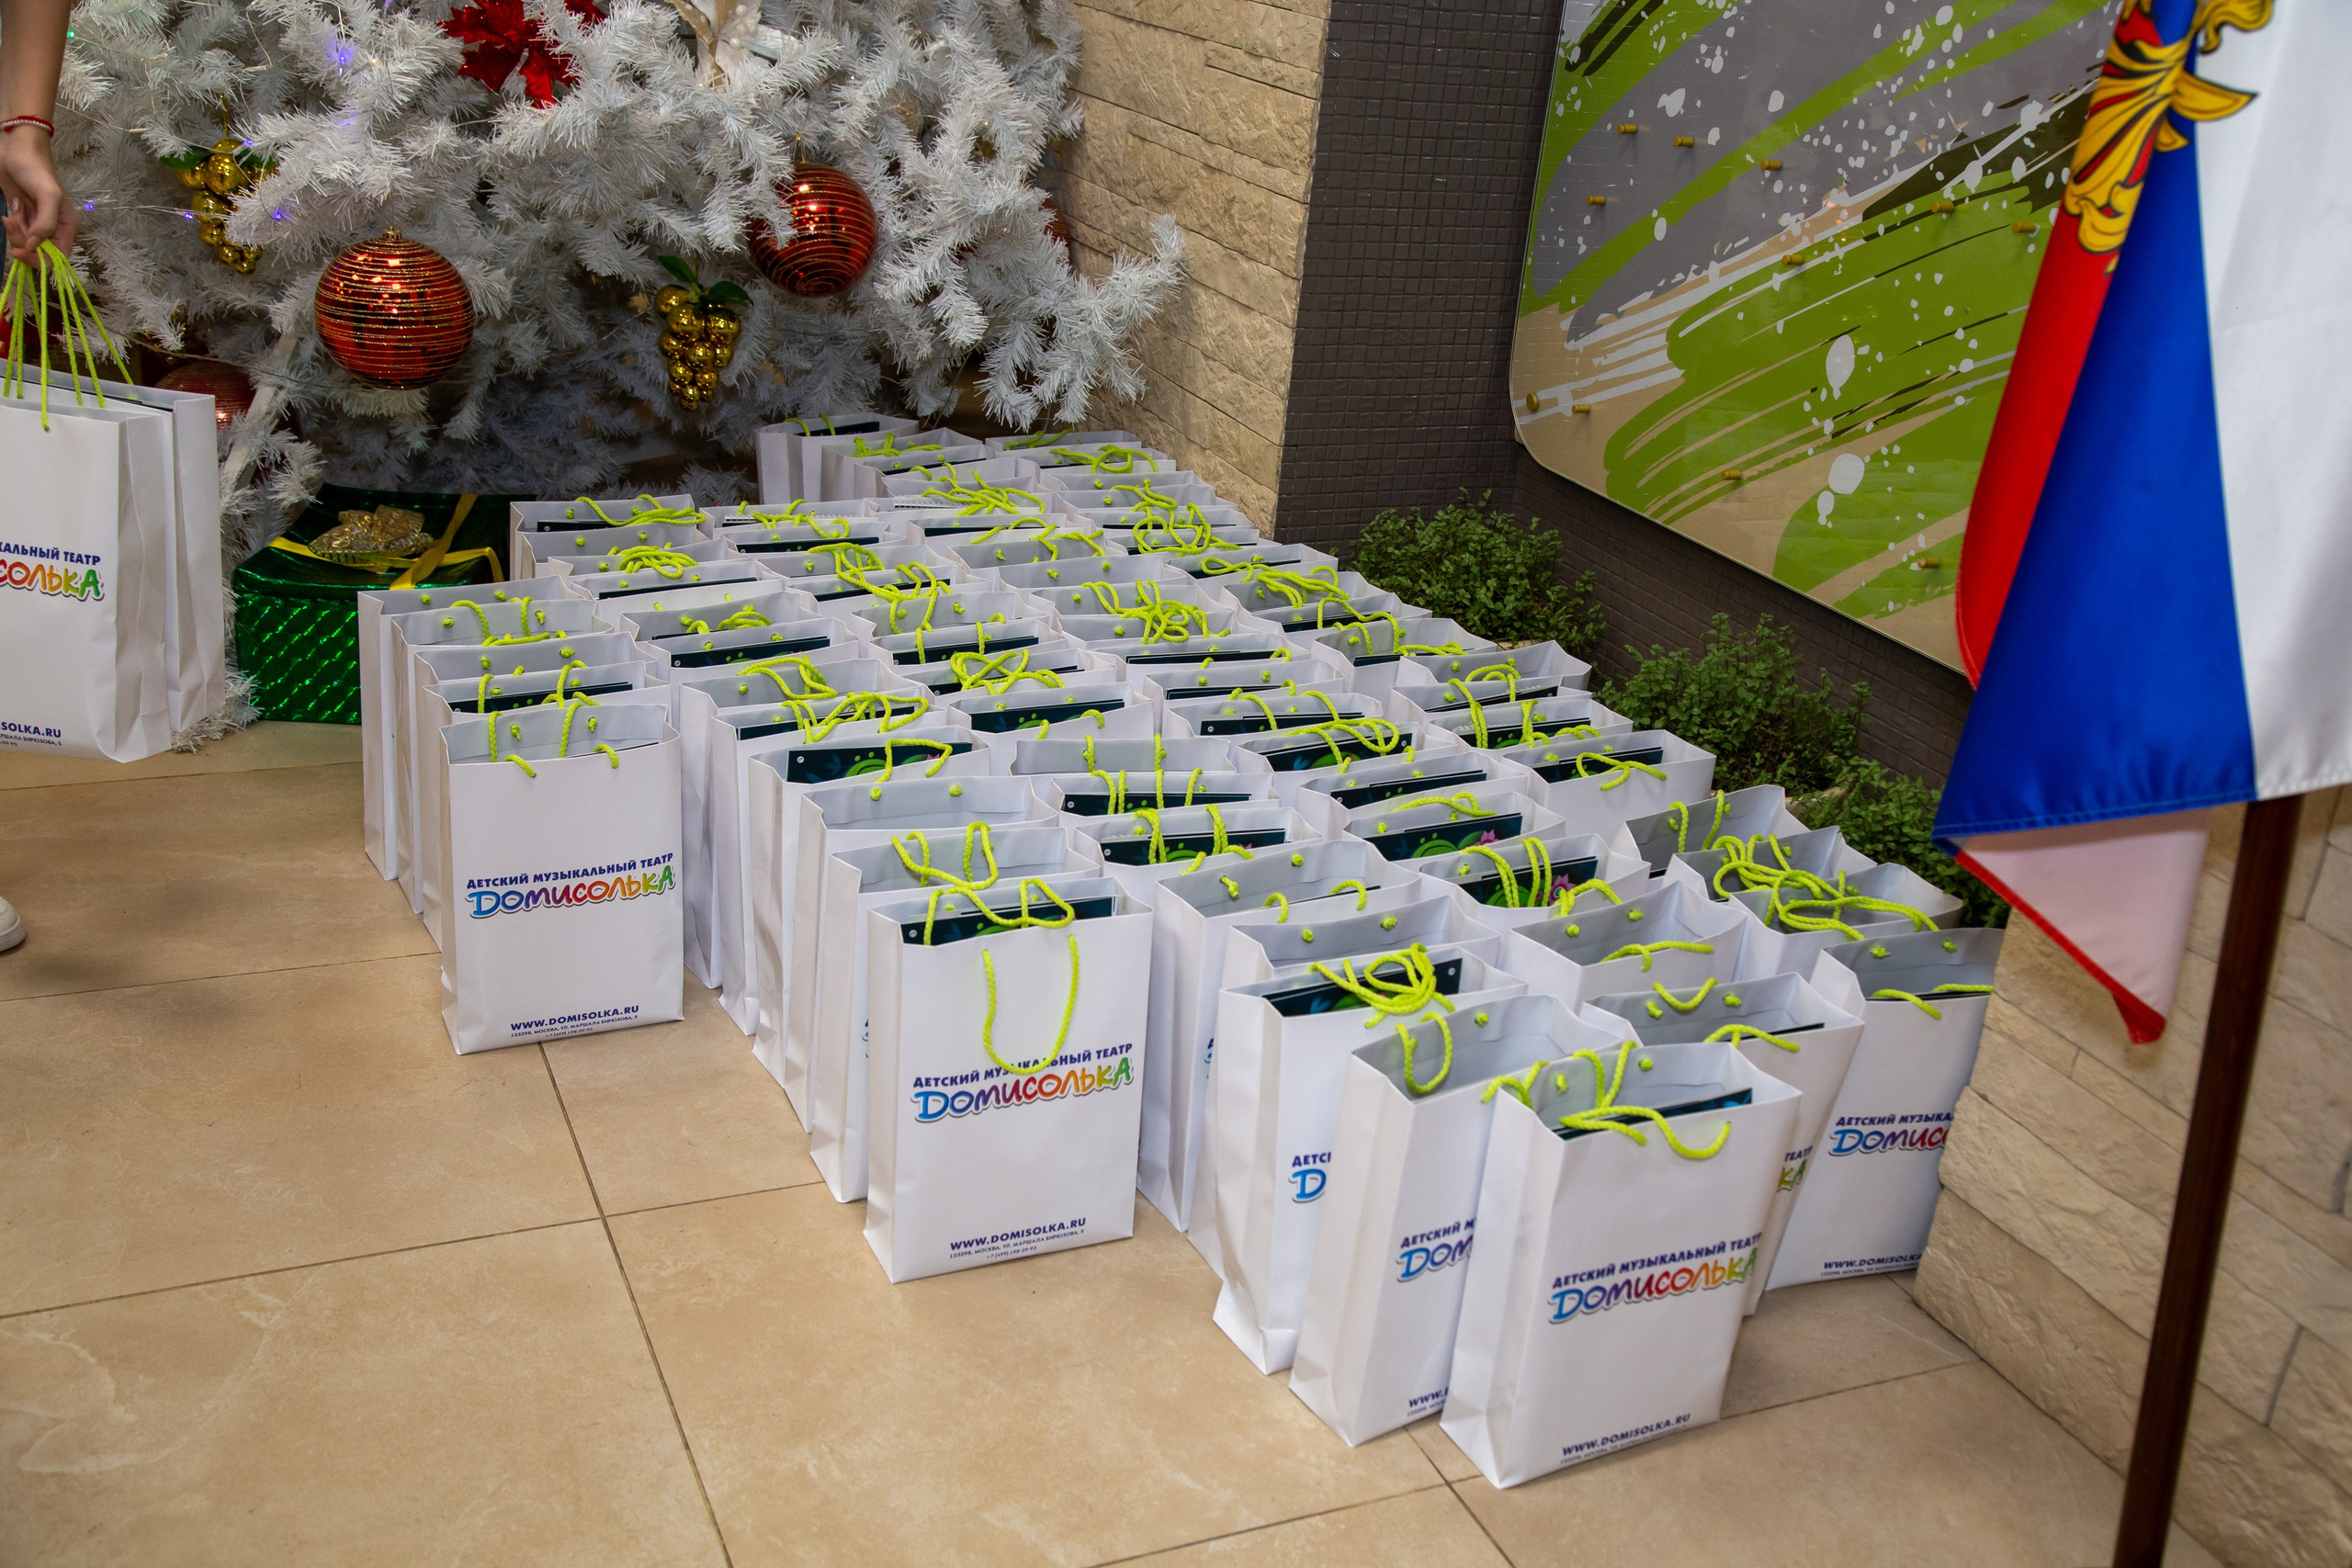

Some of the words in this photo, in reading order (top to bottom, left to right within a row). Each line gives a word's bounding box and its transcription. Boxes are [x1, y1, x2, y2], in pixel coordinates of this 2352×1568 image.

[63, 551, 101, 566] ТЕАТР
[467, 873, 529, 889] ДЕТСКИЙ
[533, 859, 637, 884] МУЗЫКАЛЬНЫЙ
[640, 852, 673, 869] ТЕАТР
[511, 1005, 639, 1031] WWW.DOMISOLKA.RU
[913, 1069, 979, 1088] ДЕТСКИЙ
[1096, 1043, 1133, 1060] ТЕАТР
[1836, 1113, 1895, 1126] ДЕТСКИЙ
[1898, 1112, 1954, 1124] МУЗЫКА
[950, 1217, 1086, 1250] WWW.DOMISOLKA.RU
[1400, 1221, 1461, 1248] ДЕТСКИЙ
[1553, 1263, 1616, 1290] ДЕТСКИЙ
[1619, 1240, 1726, 1274] МУЗЫКАЛЬНЫЙ
[1563, 1413, 1690, 1456] WWW.DOMISOLKA.RU
